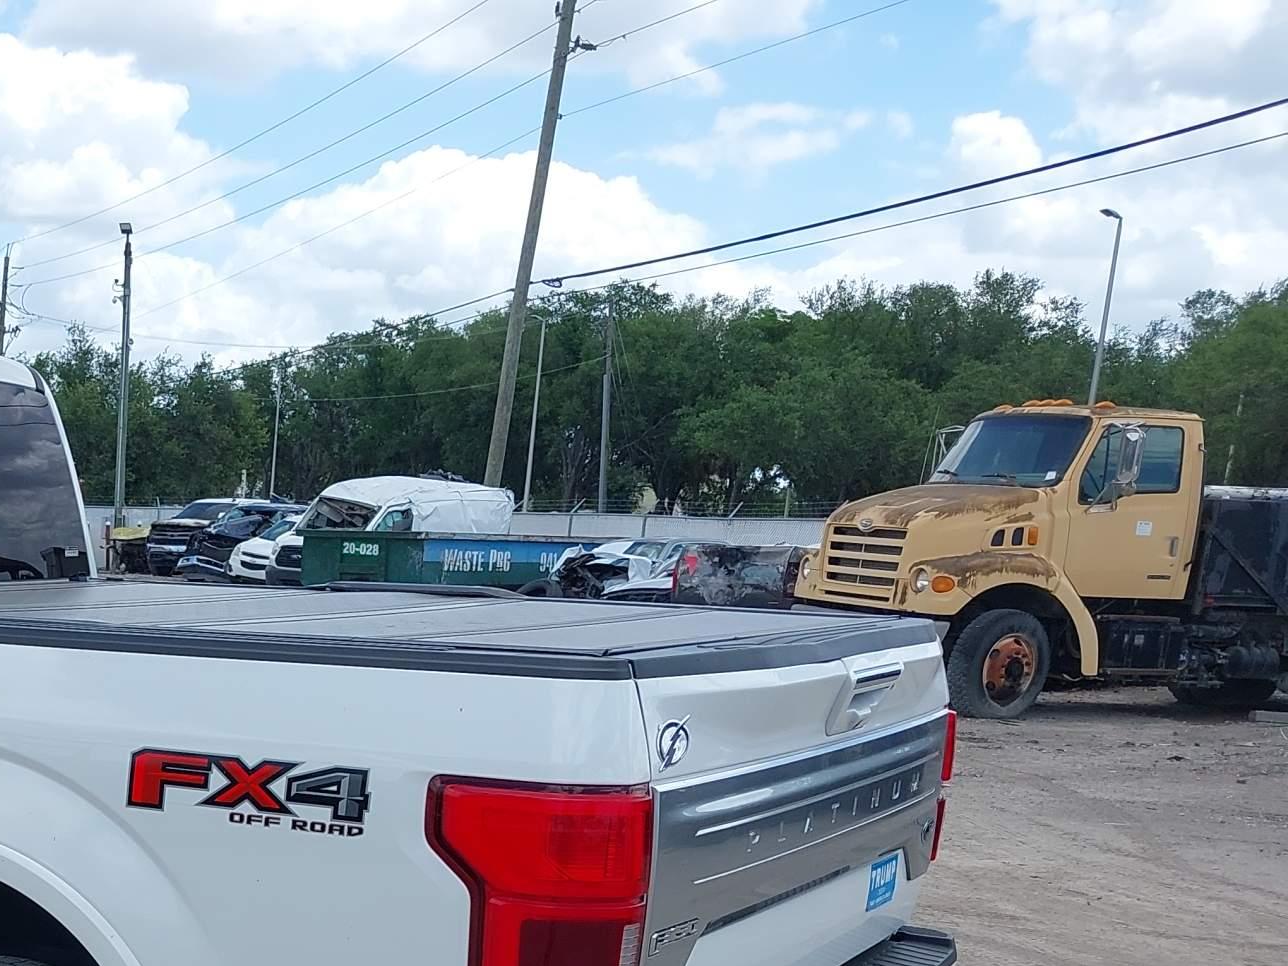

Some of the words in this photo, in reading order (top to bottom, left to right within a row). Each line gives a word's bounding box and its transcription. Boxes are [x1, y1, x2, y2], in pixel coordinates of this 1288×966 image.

[342, 541, 380, 556] 20-028
[443, 548, 485, 572] WASTE
[125, 745, 372, 825] FX4
[228, 811, 281, 828] OFF
[290, 818, 365, 838] ROAD
[746, 771, 921, 852] PLATINUM
[870, 859, 897, 892] TRUMP
